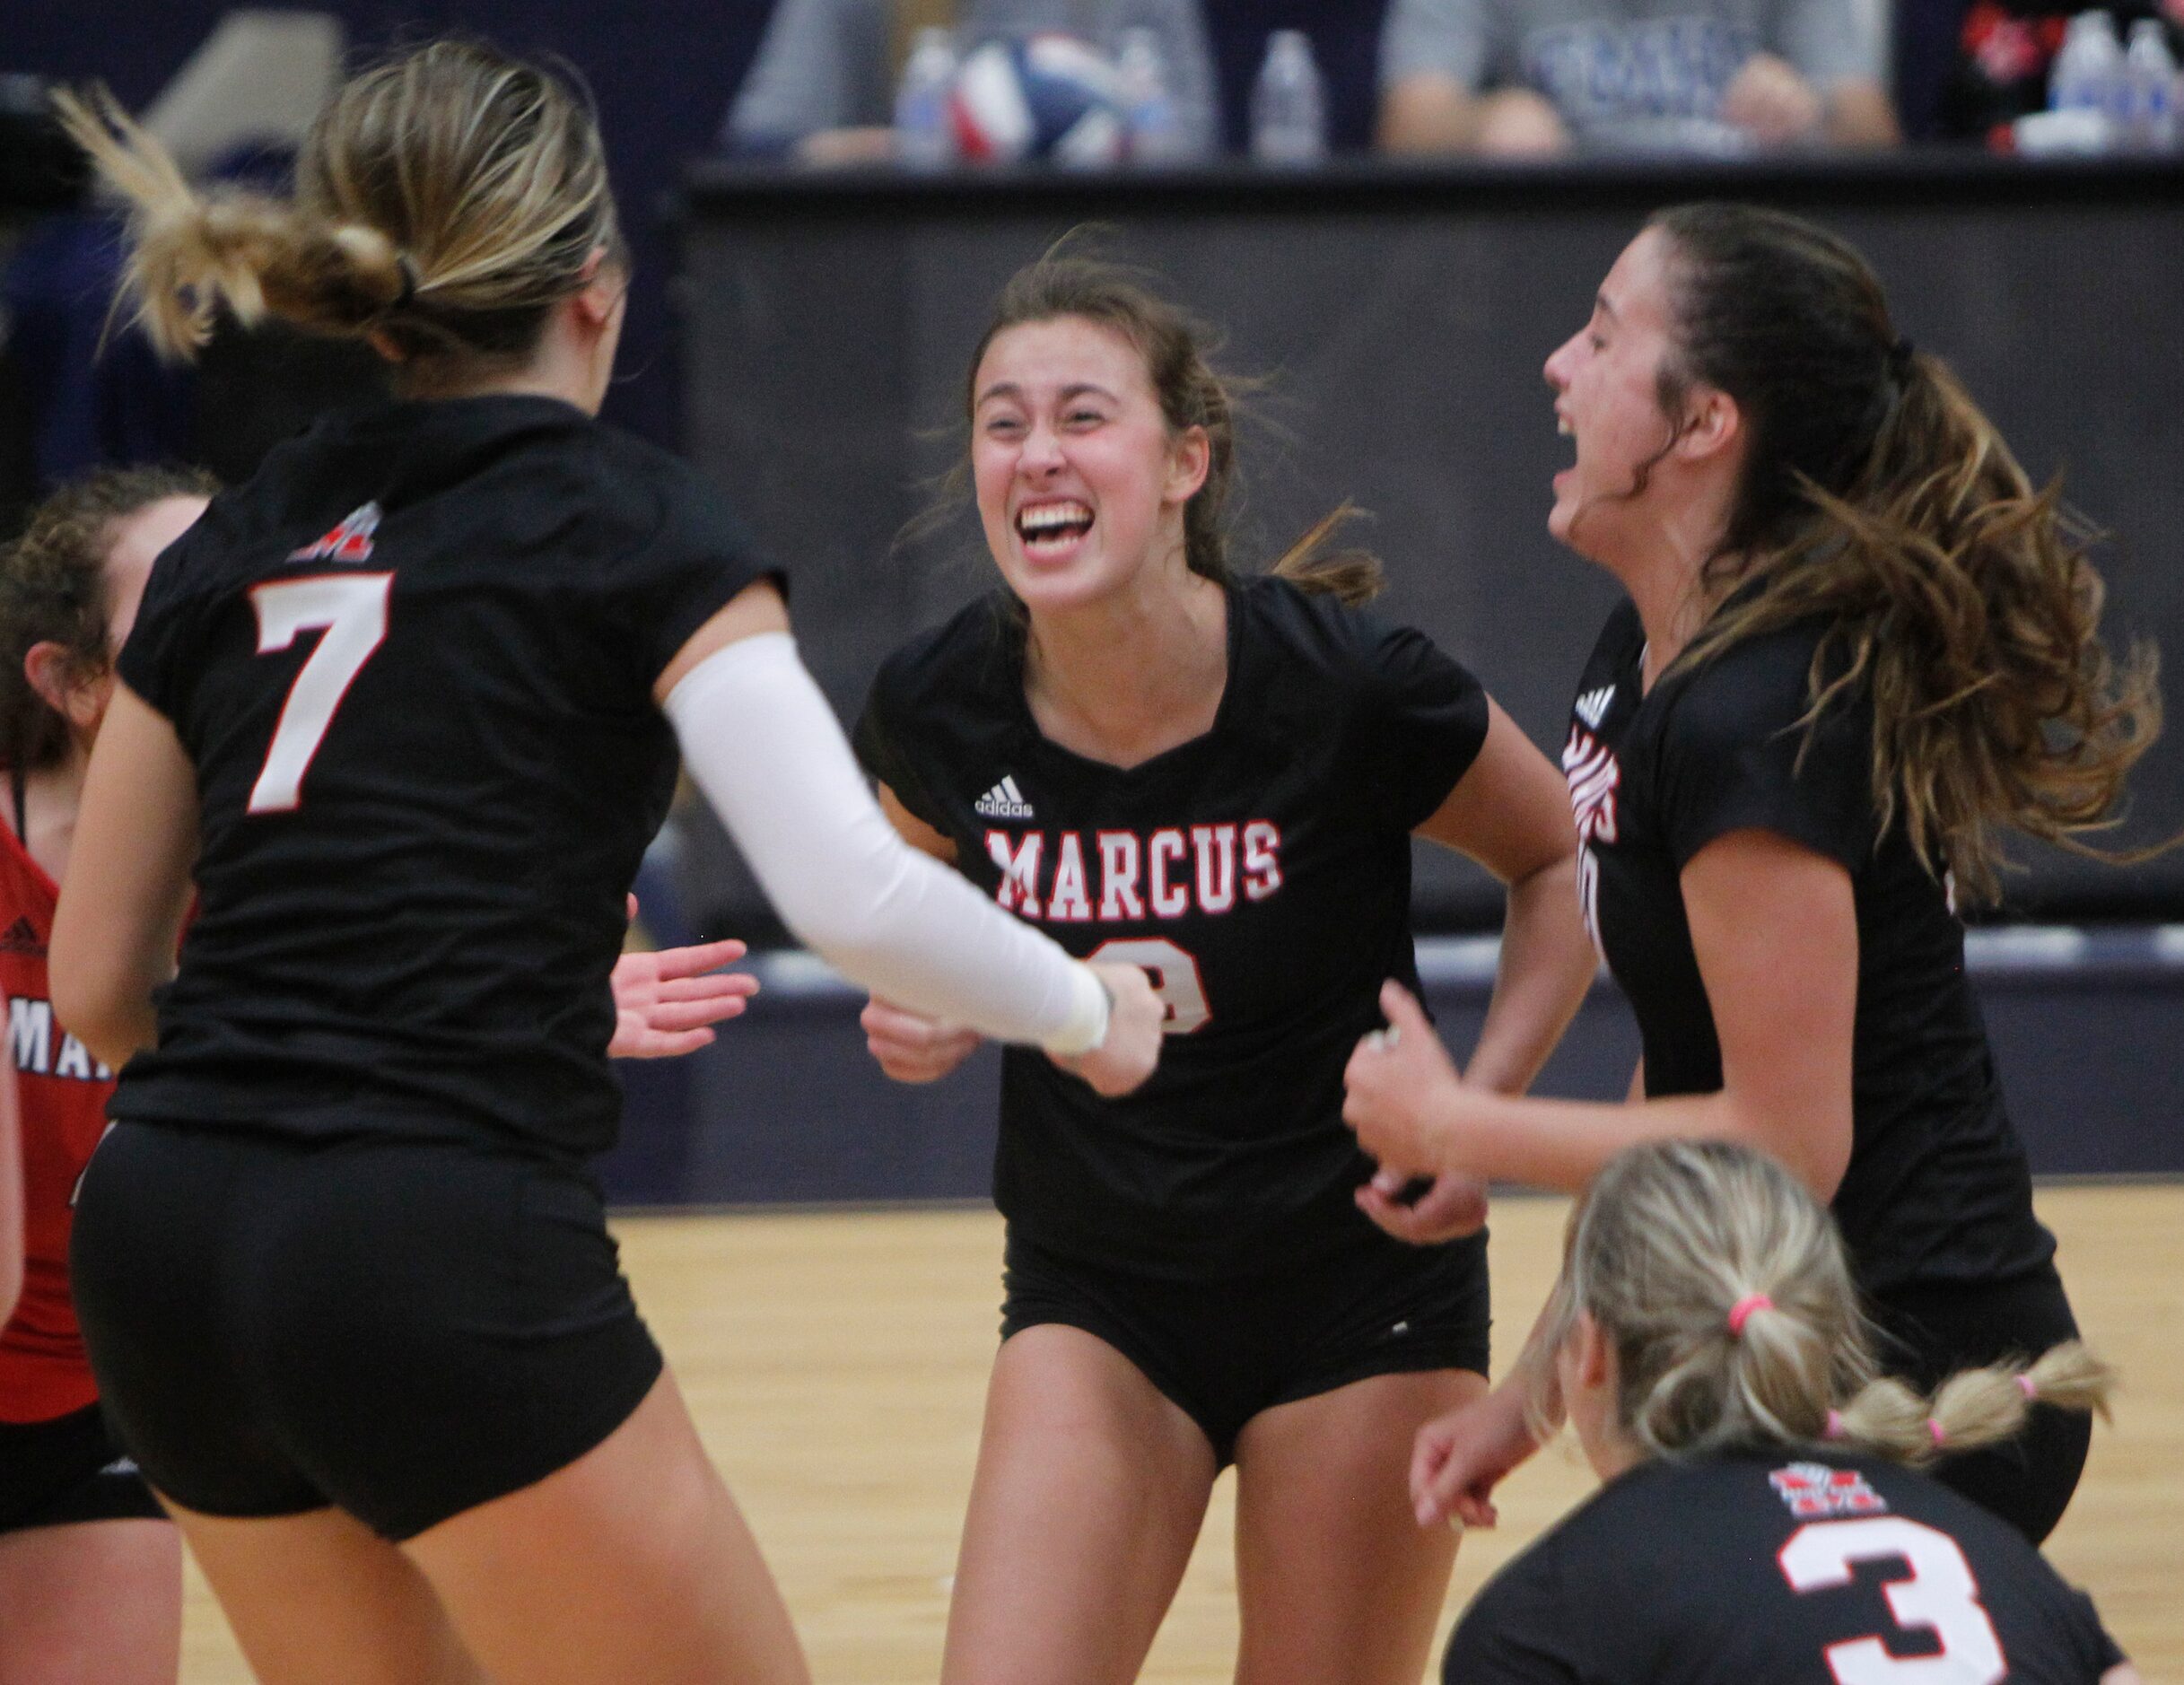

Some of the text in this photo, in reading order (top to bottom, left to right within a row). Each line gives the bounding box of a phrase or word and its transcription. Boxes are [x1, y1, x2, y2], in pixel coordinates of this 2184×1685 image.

[246, 571, 396, 815] 7
[974, 798, 1034, 818] adidas
[984, 818, 1284, 922] MARCUS
[9, 996, 114, 1082] MA
[1775, 1514, 2010, 1685] 3
